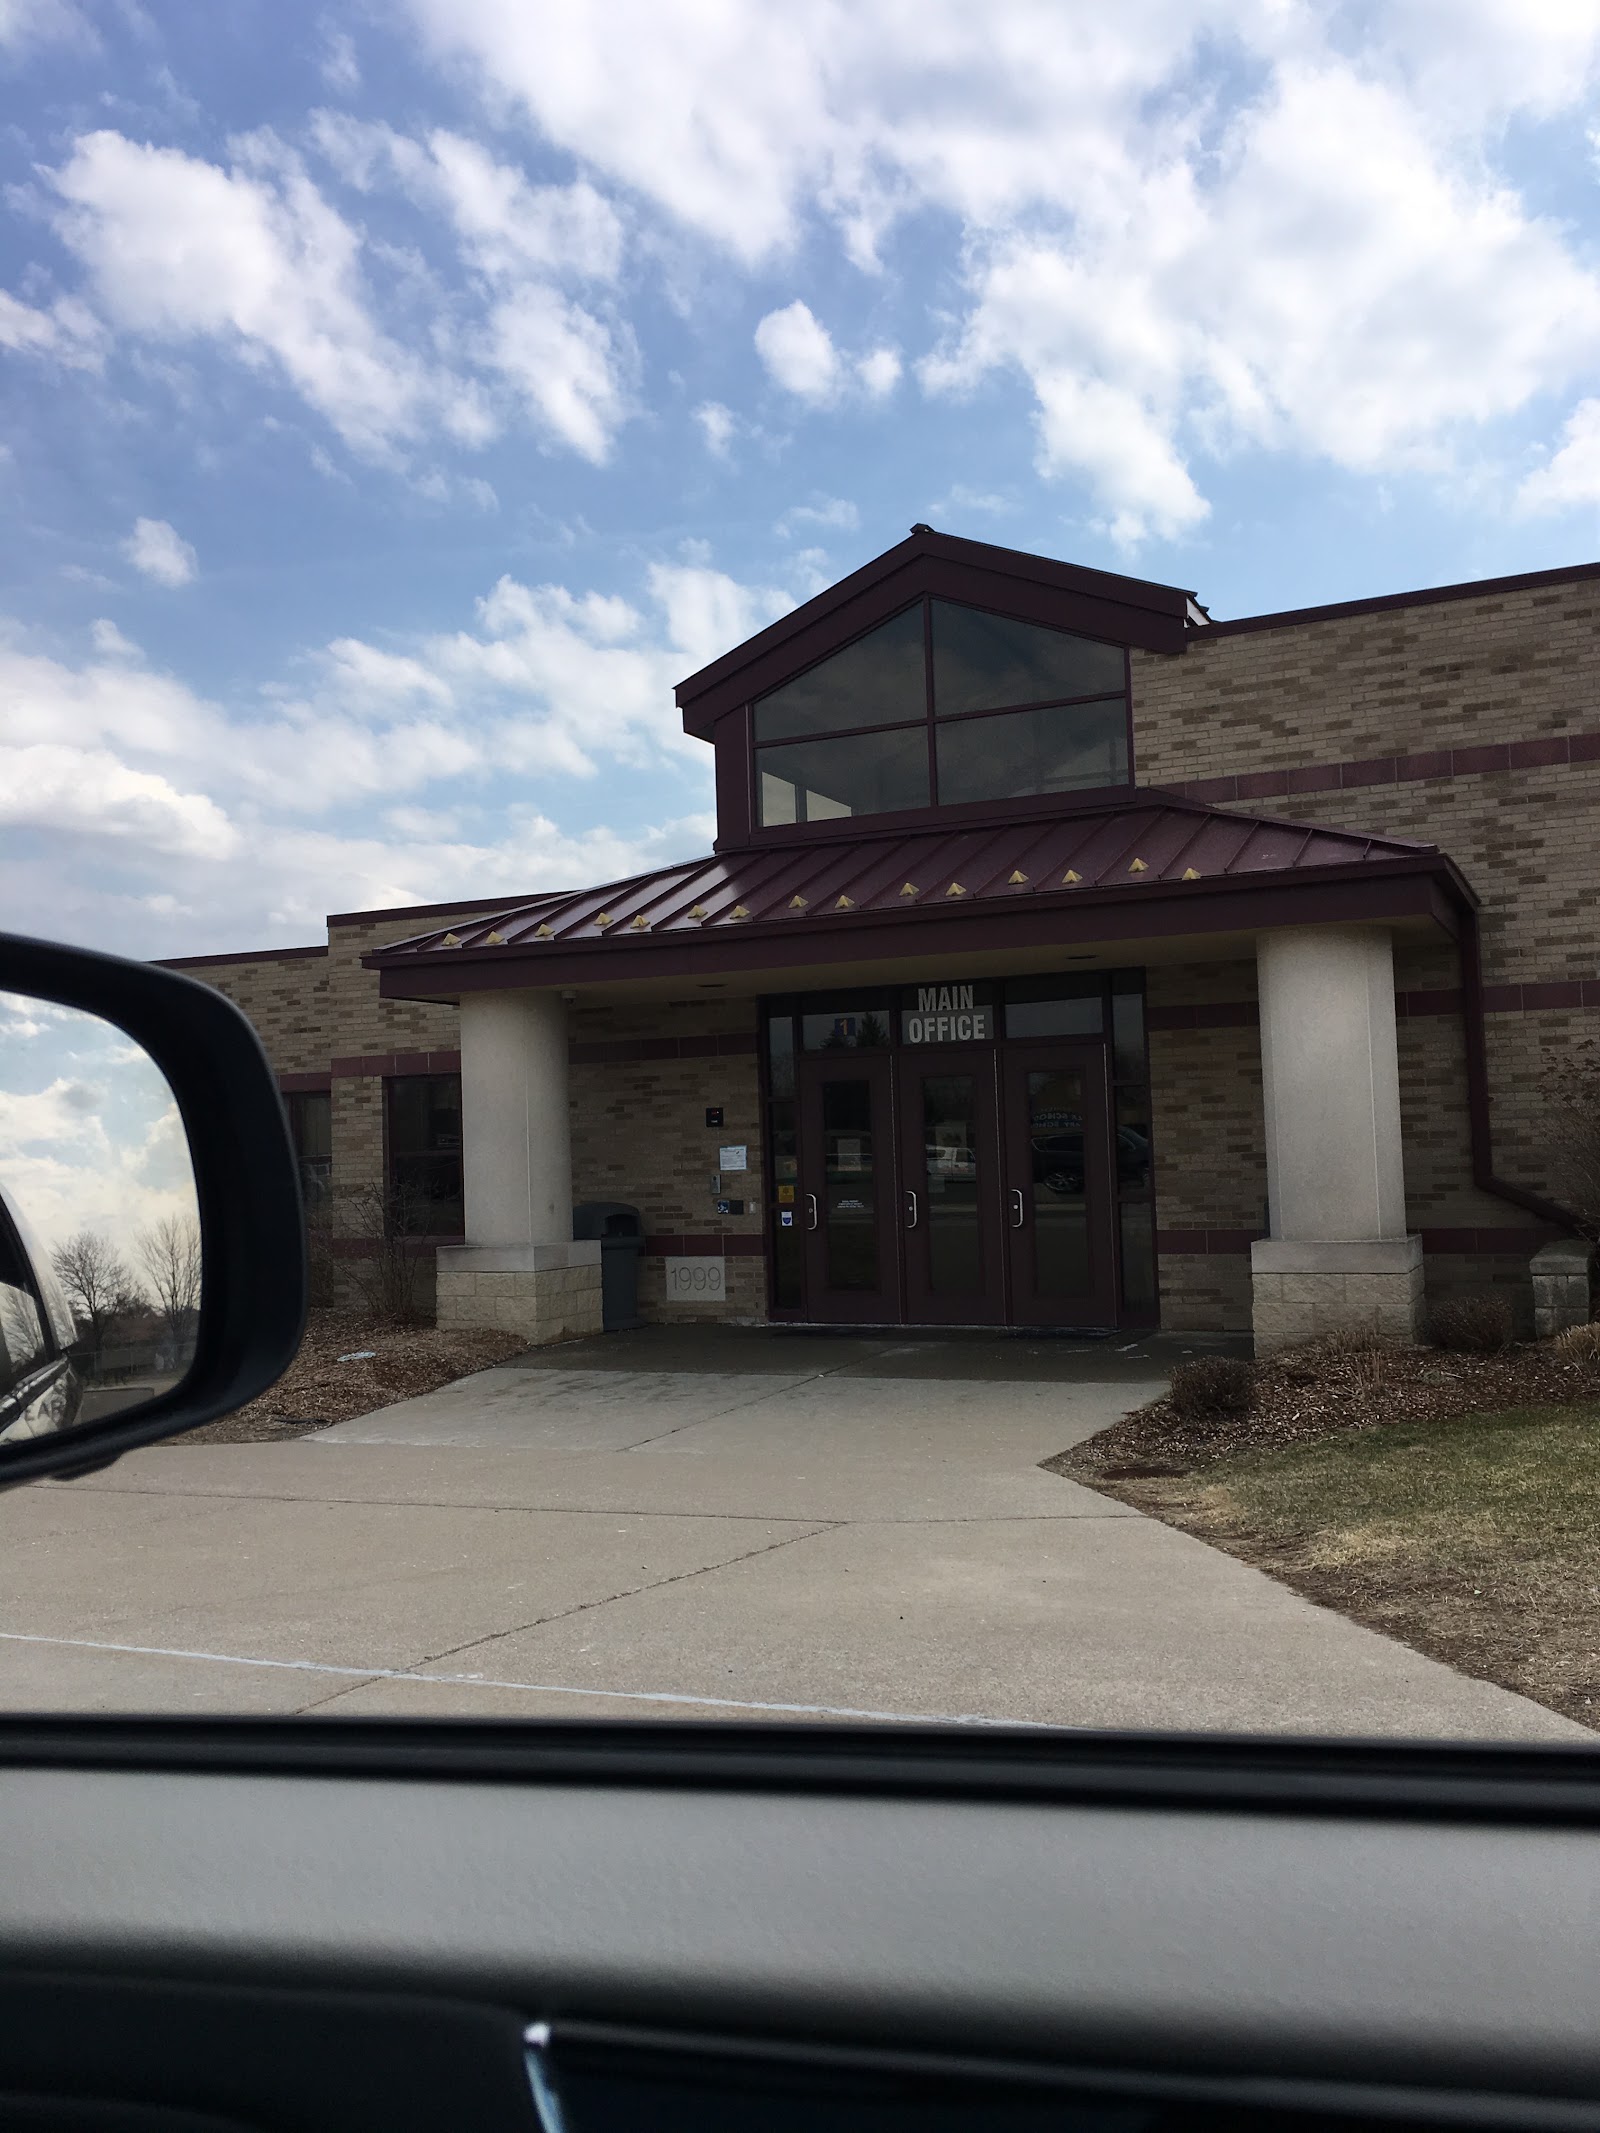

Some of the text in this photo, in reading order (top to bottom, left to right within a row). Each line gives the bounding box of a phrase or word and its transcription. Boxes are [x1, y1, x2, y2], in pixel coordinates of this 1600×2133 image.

[918, 985, 974, 1012] MAIN
[839, 1018, 849, 1035] 1
[908, 1014, 985, 1043] OFFICE
[670, 1266, 721, 1291] 1999
